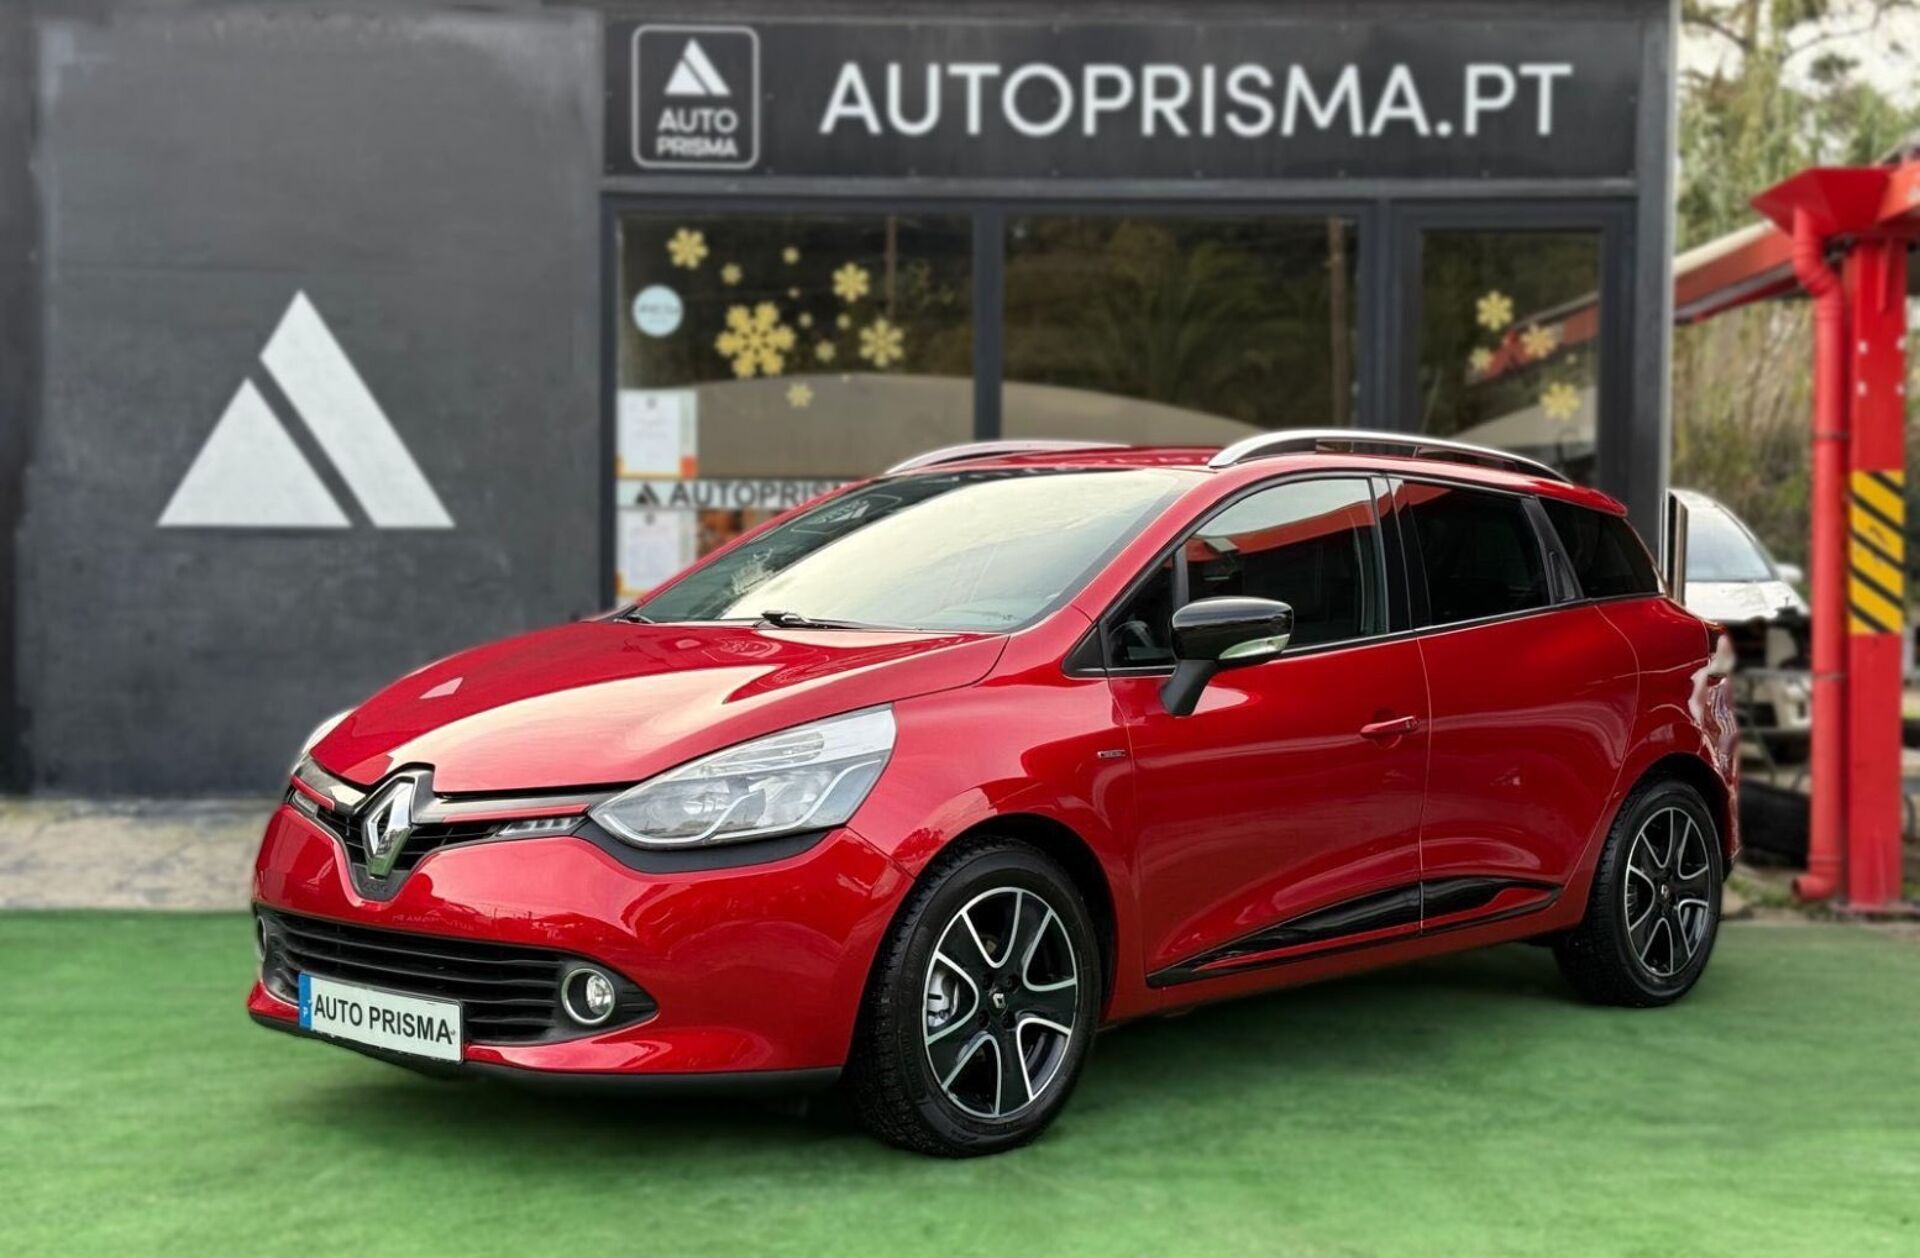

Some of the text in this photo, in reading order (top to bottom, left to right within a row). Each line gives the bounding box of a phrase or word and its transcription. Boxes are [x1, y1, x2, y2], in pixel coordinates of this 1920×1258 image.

[819, 62, 1573, 137] AUTOPRISMA.PT
[658, 108, 739, 133] AUTO
[656, 136, 738, 156] PRISMA
[671, 482, 840, 505] AUTOPRIS
[314, 993, 453, 1045] AUTO PRISMA
